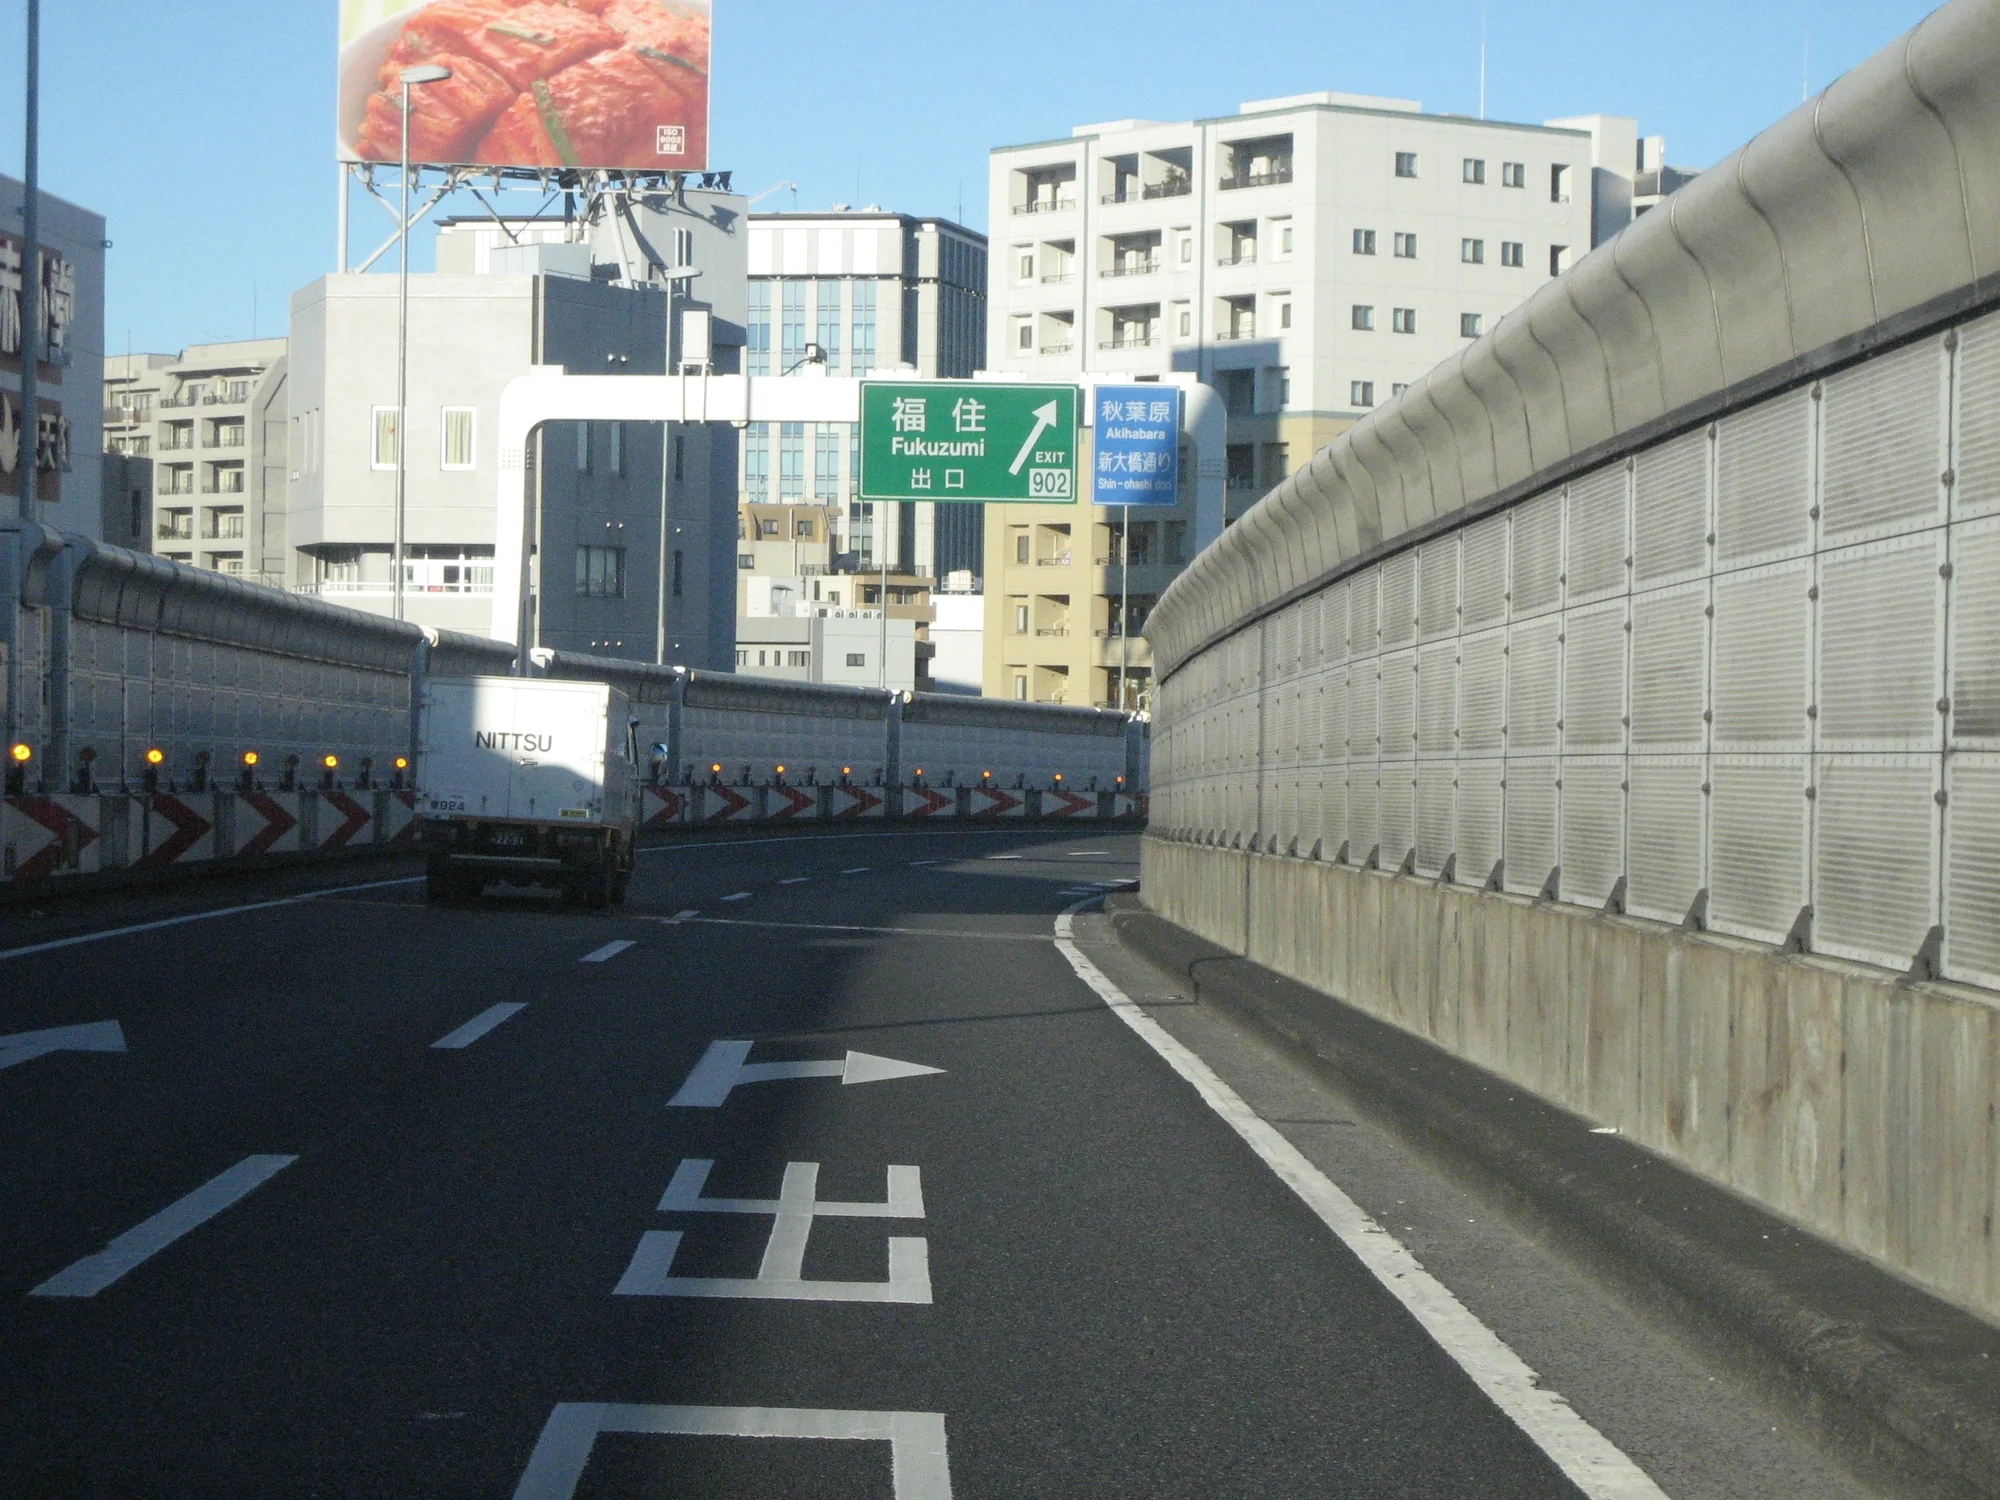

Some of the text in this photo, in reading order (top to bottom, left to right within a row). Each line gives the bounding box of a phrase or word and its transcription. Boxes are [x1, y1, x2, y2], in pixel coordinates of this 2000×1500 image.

[891, 397, 987, 433] 福住
[1102, 400, 1170, 422] 秋葉原
[1106, 427, 1166, 440] Akihabara
[891, 437, 985, 457] Fukuzumi
[1035, 451, 1065, 464] EXIT
[1098, 451, 1171, 473] 新大橋通り
[911, 467, 965, 490] 出口
[1032, 471, 1068, 494] 902
[475, 731, 552, 753] NITTSU
